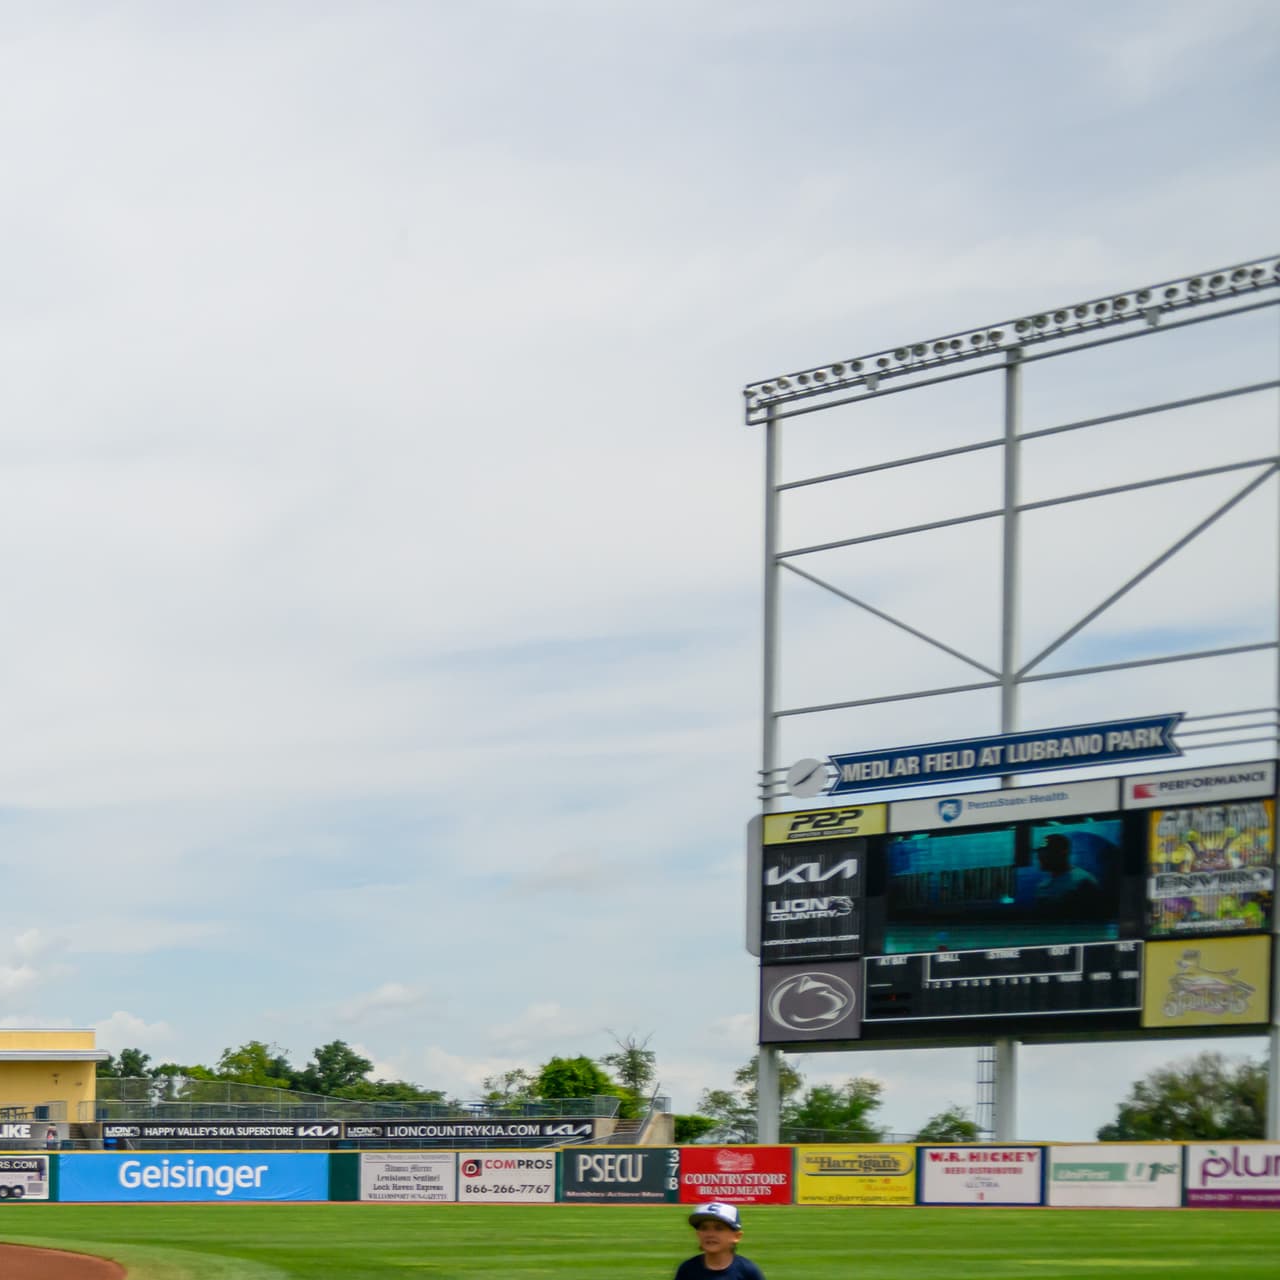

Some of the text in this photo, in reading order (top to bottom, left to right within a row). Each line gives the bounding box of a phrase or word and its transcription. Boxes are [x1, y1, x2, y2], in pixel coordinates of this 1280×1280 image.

[843, 726, 1164, 782] MEDLAR FIELD AT LUBRANO PARK
[1159, 770, 1268, 792] PERFORMANCE
[1029, 792, 1069, 803] Health
[790, 809, 864, 831] P2P
[766, 858, 858, 885] KIA
[770, 898, 830, 914] LION
[769, 909, 839, 921] COUNTRY
[145, 1126, 339, 1136] HAPPY VALLEY'S KIA SUPERSTORE KIA
[387, 1124, 592, 1137] LIONCOUNTRYKIA.COM KIA
[929, 1152, 1038, 1162] W.R. HICKEY
[485, 1159, 553, 1170] COMPROS
[577, 1154, 643, 1182] PSECU
[119, 1159, 269, 1196] Geisinger
[377, 1174, 440, 1182] Lewistown Sentinel
[684, 1173, 787, 1185] COUNTRY STORE
[416, 1184, 444, 1192] Express
[465, 1184, 551, 1194] 866-266-7767
[698, 1186, 772, 1195] BRAND MEATS
